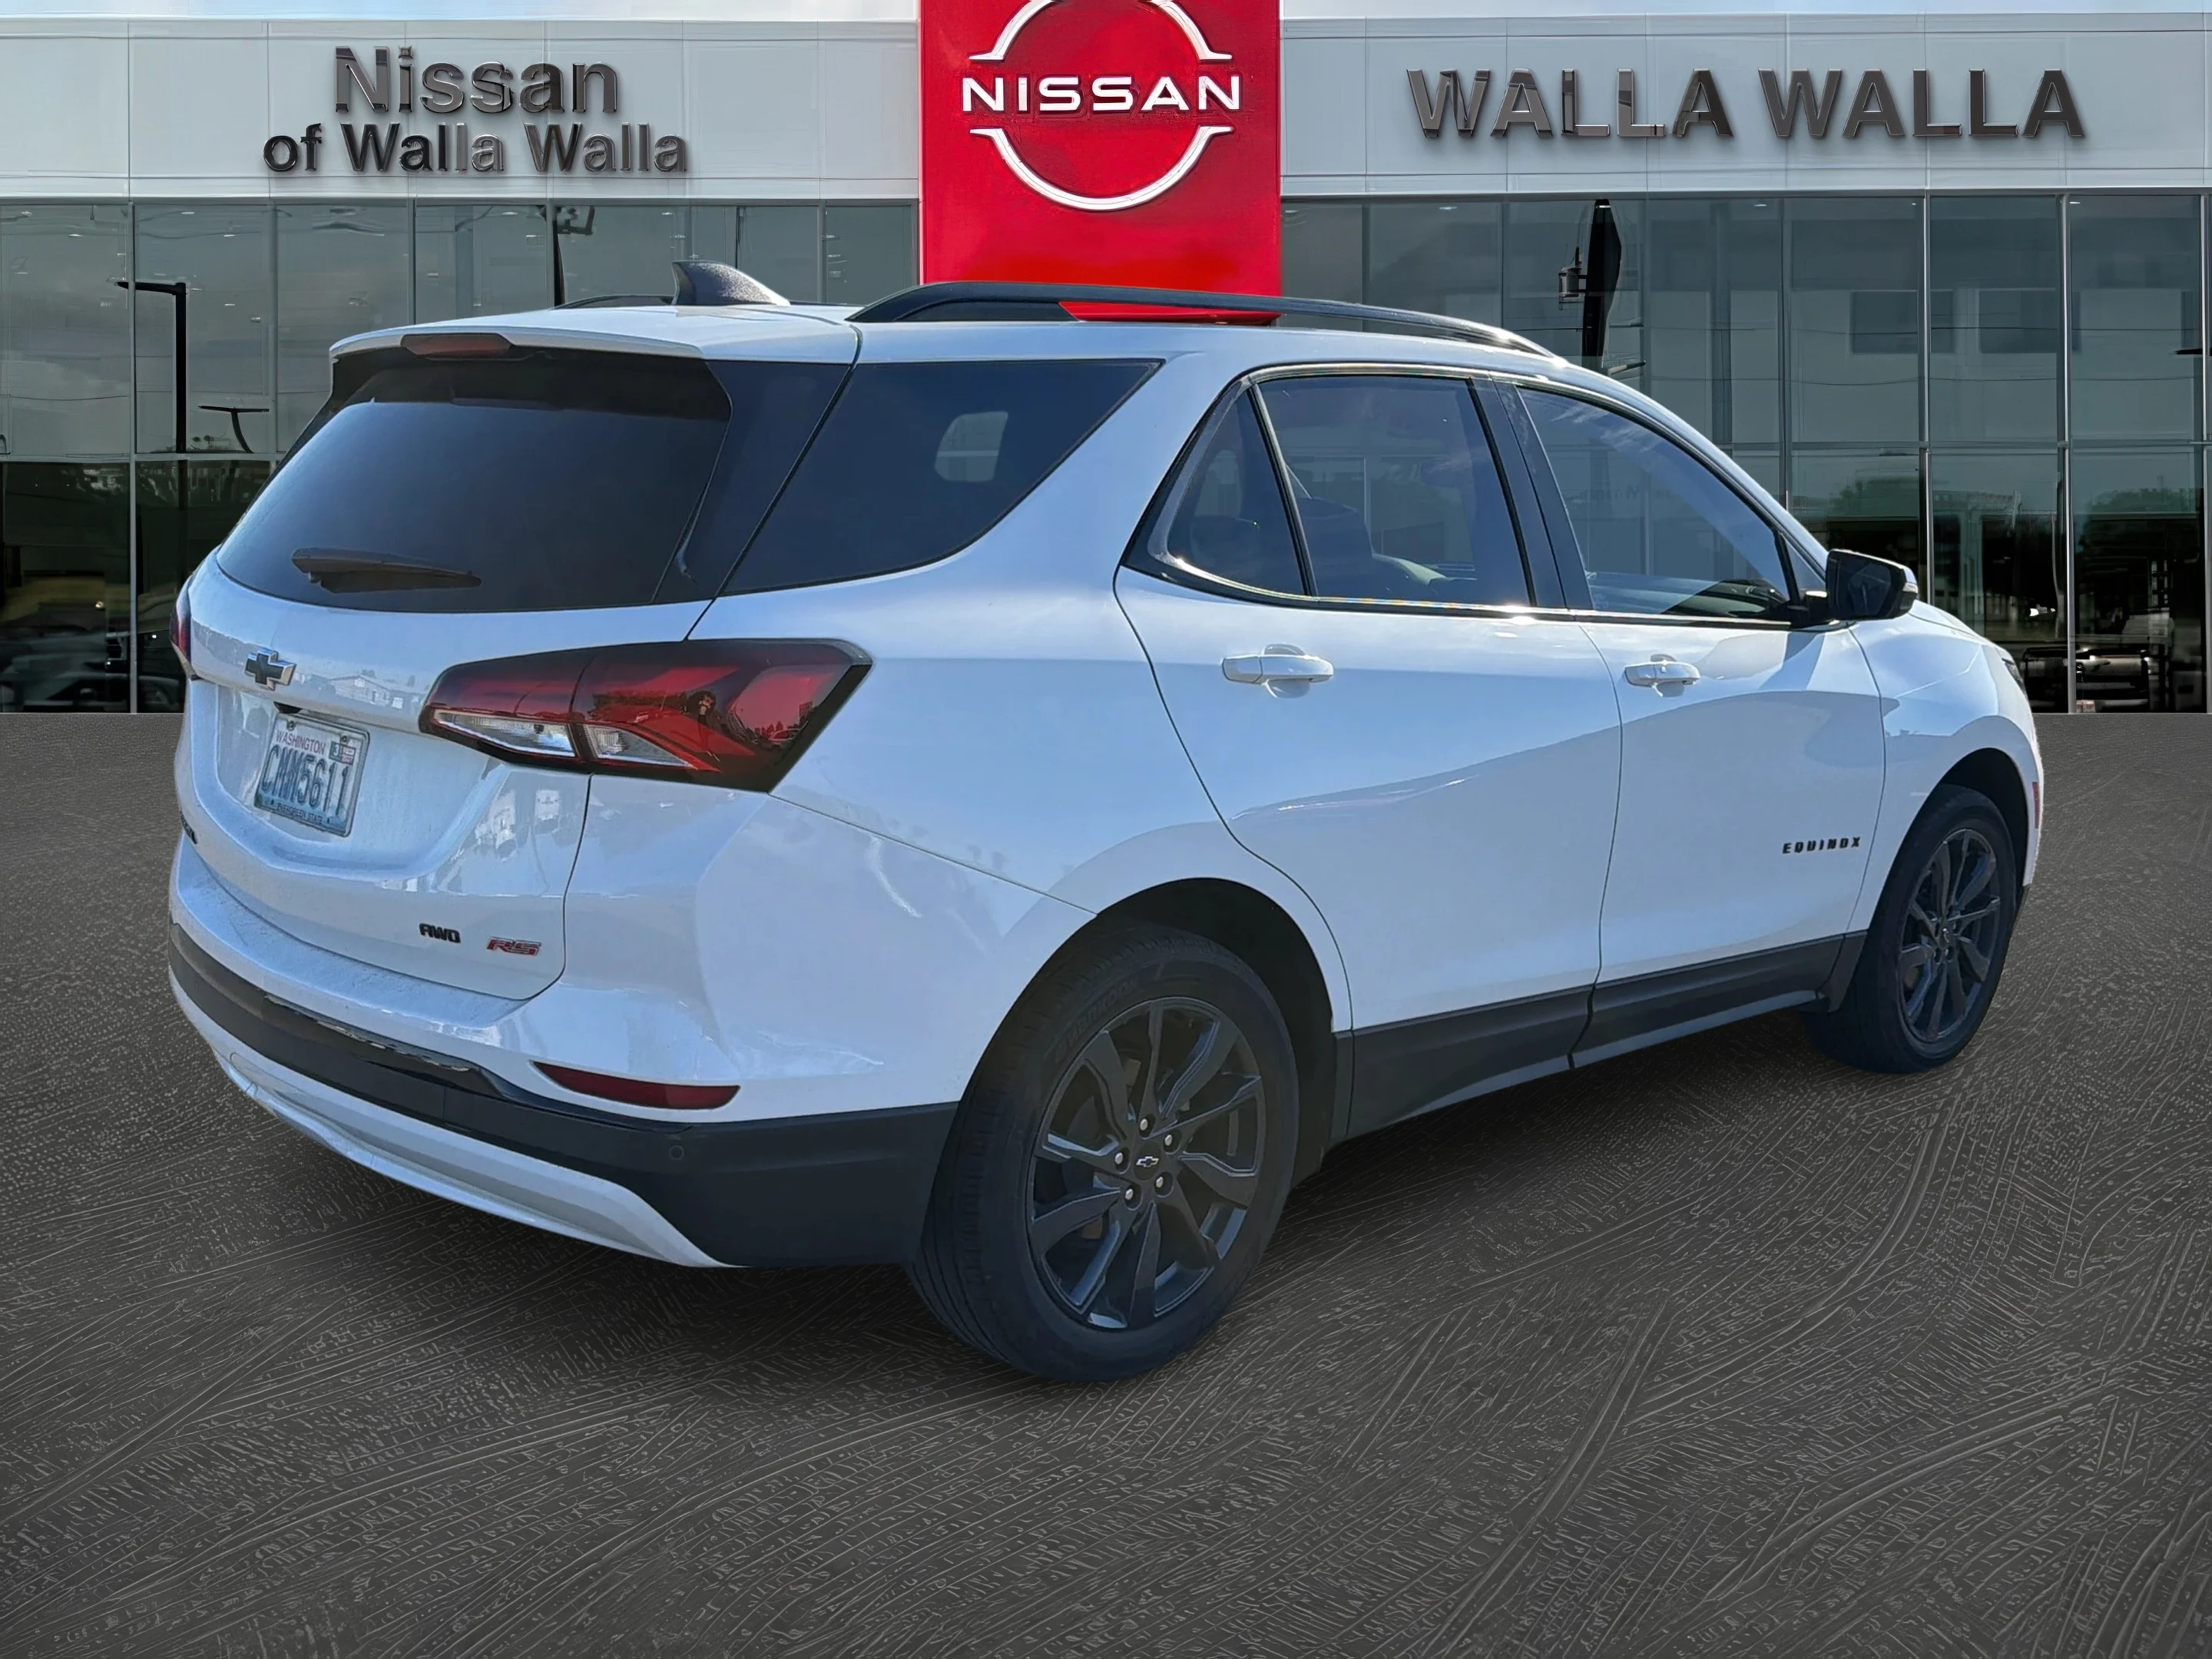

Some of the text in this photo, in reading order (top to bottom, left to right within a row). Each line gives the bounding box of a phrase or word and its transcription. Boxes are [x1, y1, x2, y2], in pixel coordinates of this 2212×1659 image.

[334, 45, 618, 113] Nissan
[962, 75, 1240, 112] NISSAN
[1406, 68, 2086, 139] WALLA WALLA
[263, 121, 687, 172] of Walla Walla
[276, 730, 326, 755] WASHINGTON
[307, 811, 324, 824] STATE
[1782, 836, 1861, 854] EQUINOX
[419, 922, 462, 944] AWD
[486, 935, 542, 956] RS
